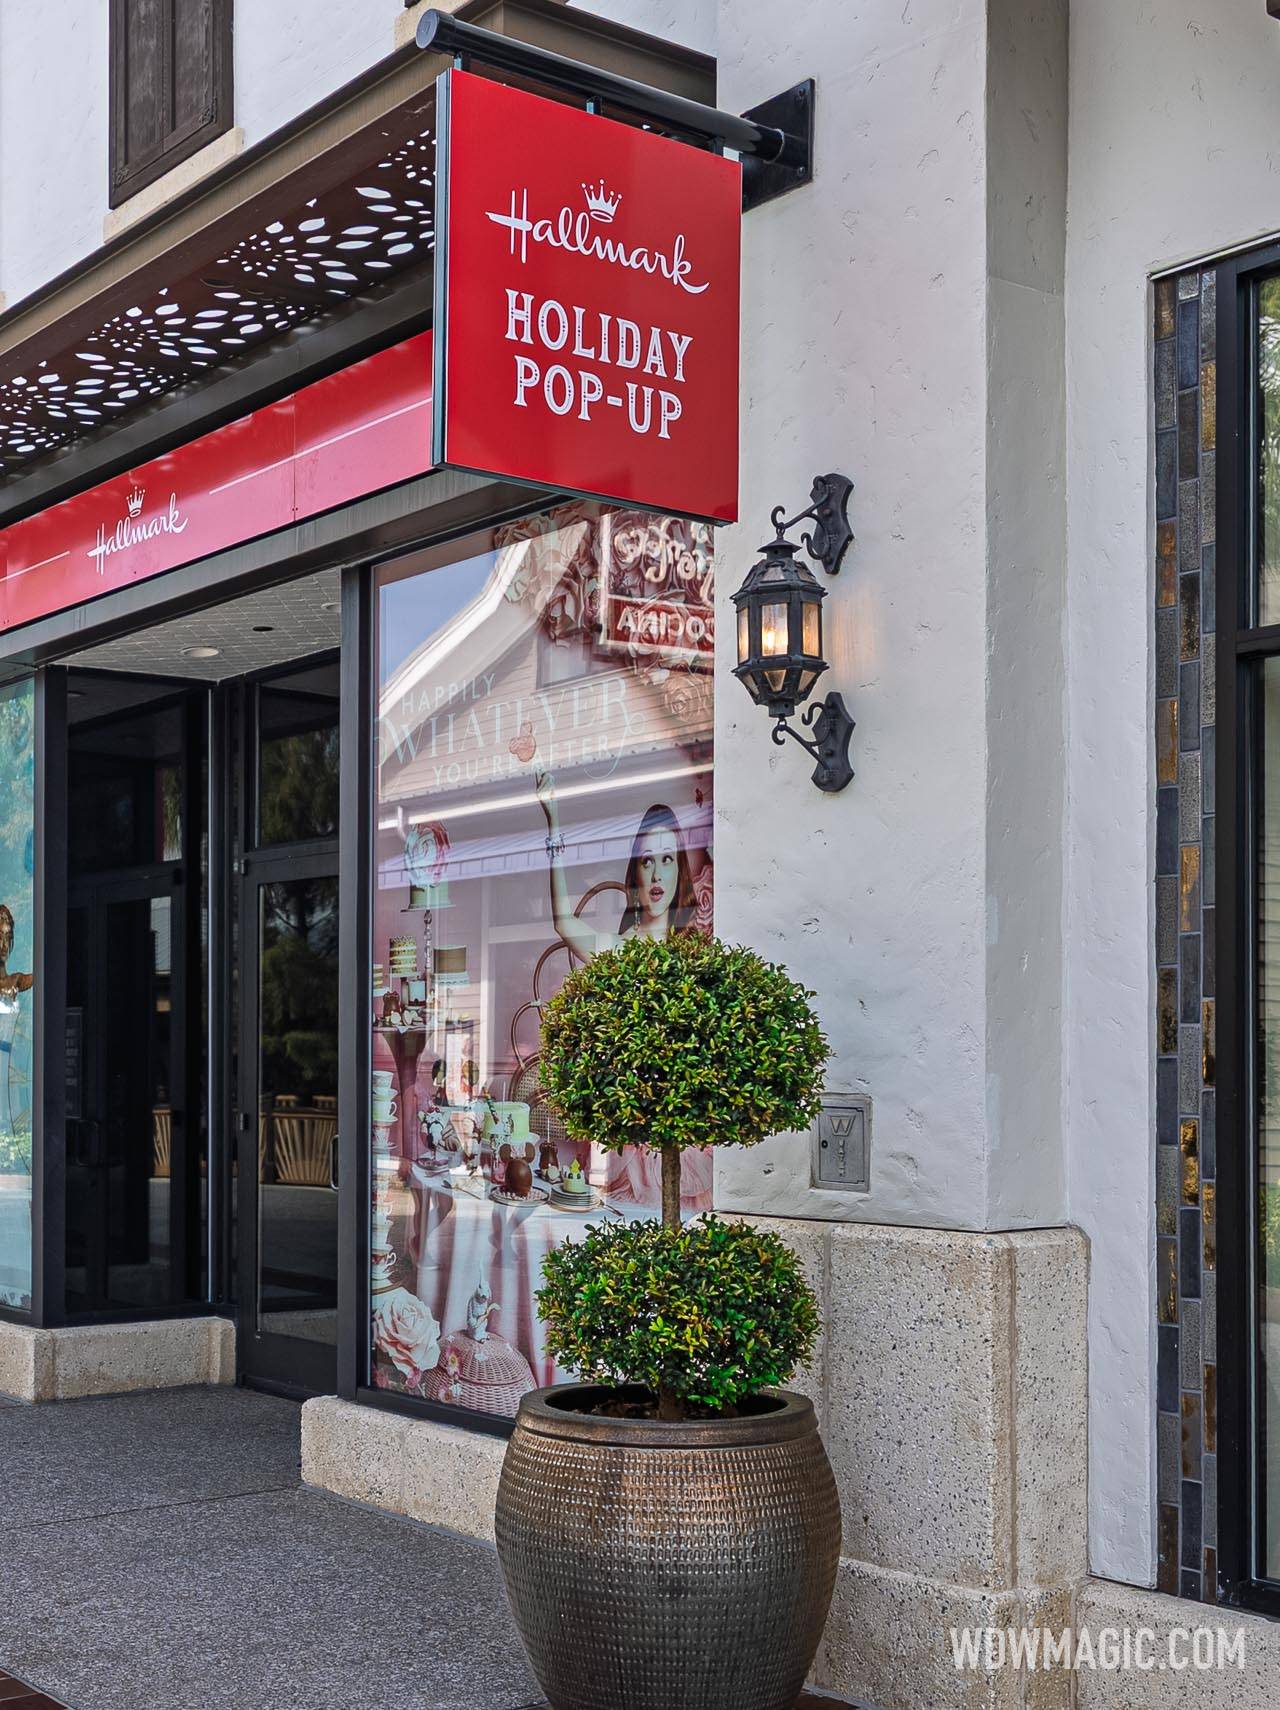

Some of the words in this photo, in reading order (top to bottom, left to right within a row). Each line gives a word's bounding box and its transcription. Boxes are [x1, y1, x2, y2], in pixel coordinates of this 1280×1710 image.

[484, 188, 710, 295] Hallmark
[503, 288, 694, 383] HOLIDAY
[513, 355, 682, 440] POP-UP
[86, 492, 189, 576] Hallmark
[377, 677, 642, 770] WHATEVER
[401, 673, 497, 715] HAPPILY
